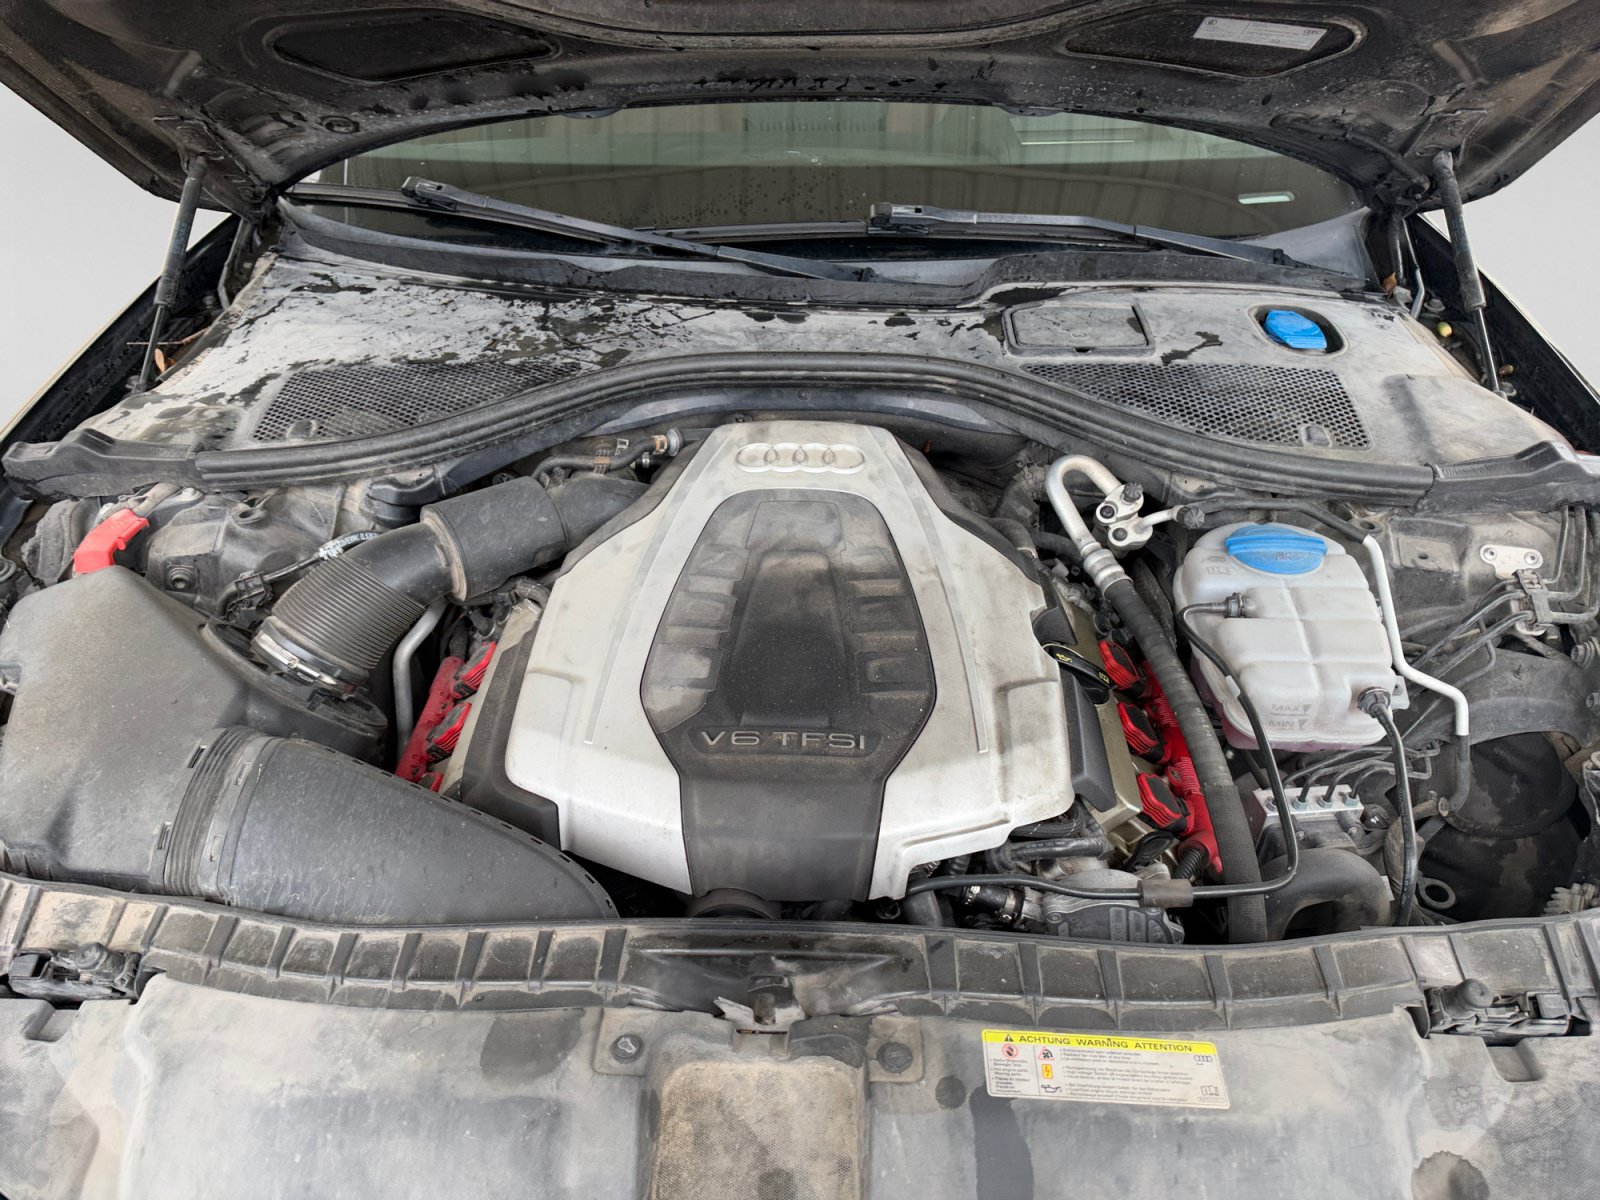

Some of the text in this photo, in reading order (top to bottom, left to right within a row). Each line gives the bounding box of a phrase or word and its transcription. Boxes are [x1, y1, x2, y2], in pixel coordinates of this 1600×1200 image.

[701, 730, 865, 750] V6 TFSI
[1019, 1035, 1192, 1052] ACHTUNG WARNING ATTENTION
